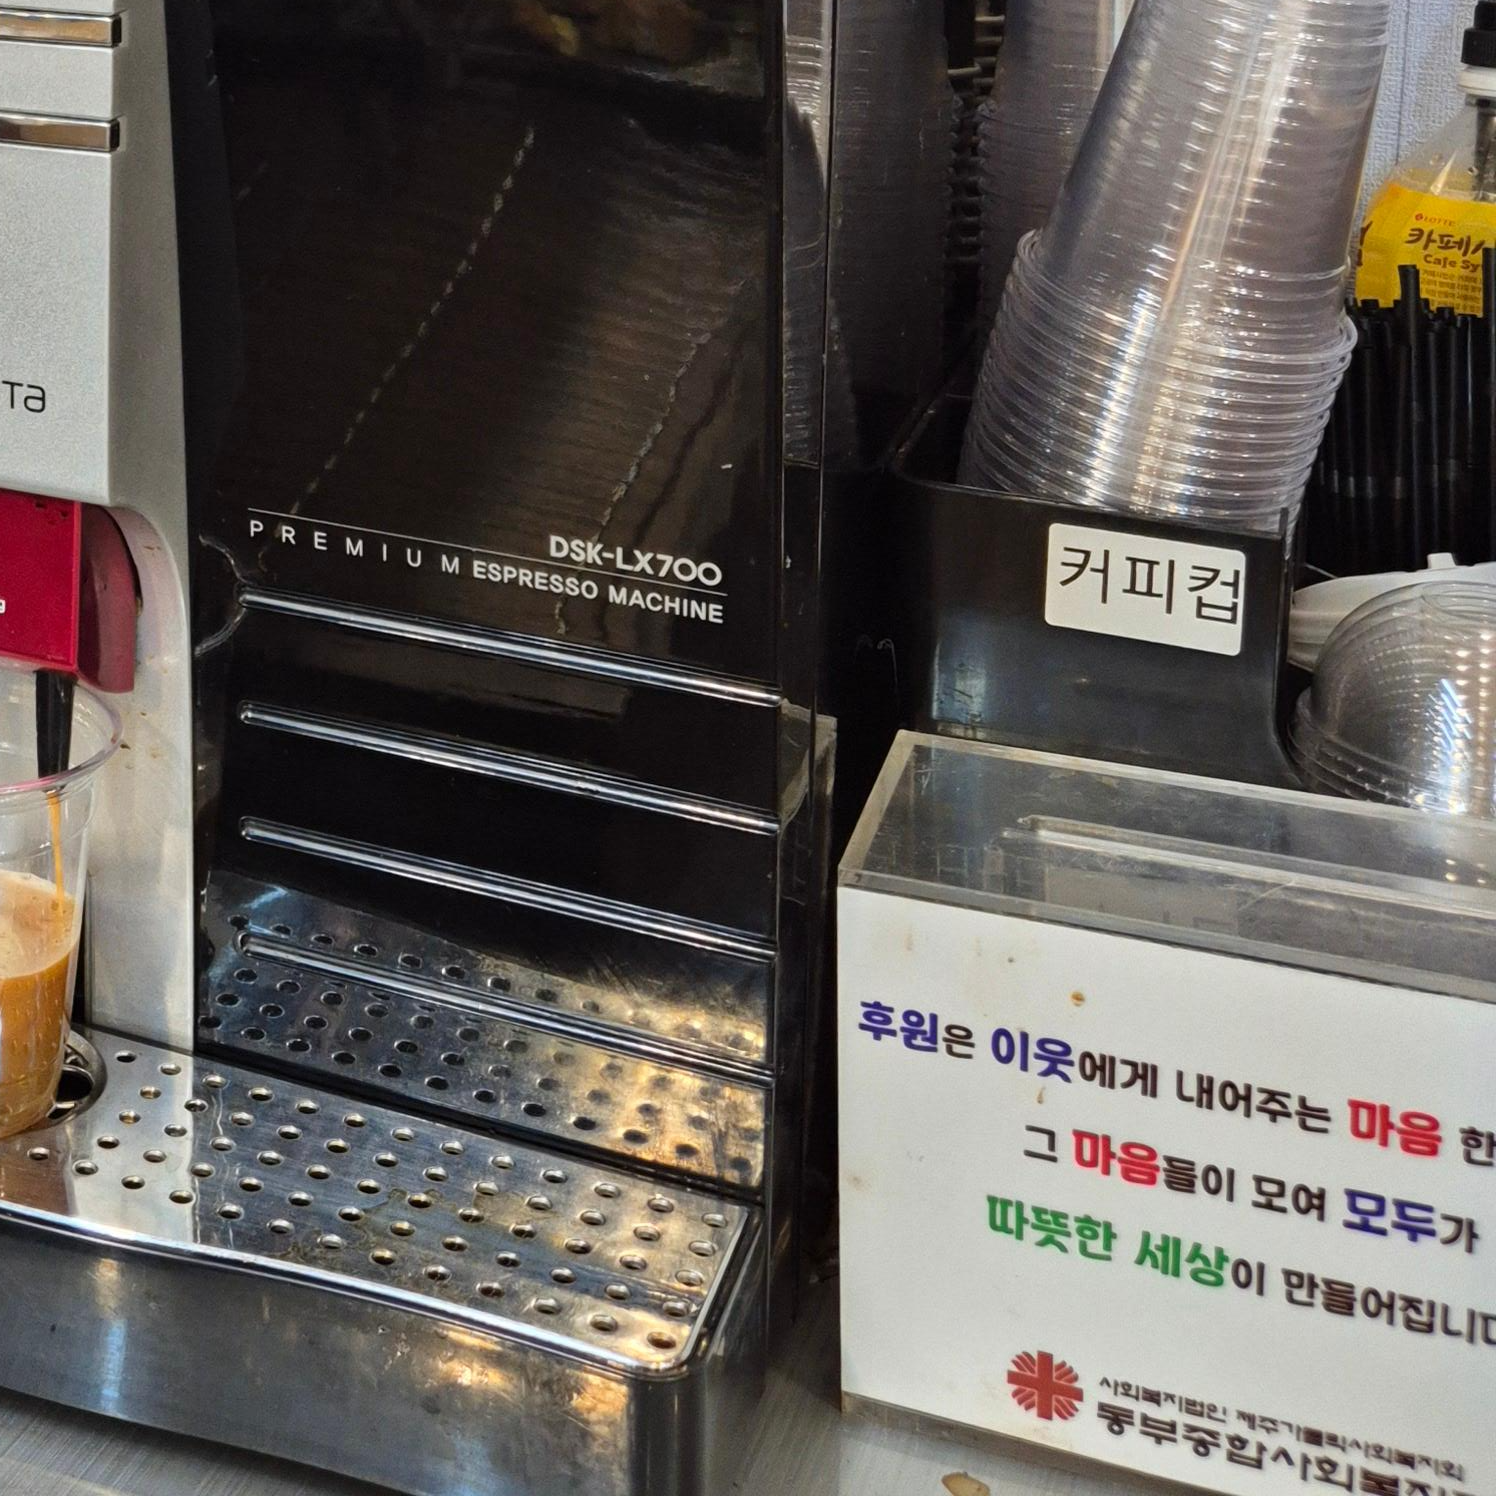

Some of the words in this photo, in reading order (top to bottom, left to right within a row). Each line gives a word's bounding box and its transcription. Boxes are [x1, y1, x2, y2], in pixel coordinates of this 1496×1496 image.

[1423, 253, 1457, 269] Cafe
[1459, 259, 1482, 273] Sy
[472, 560, 600, 601] ESPRESSO
[608, 584, 726, 624] MACHINE
[548, 534, 724, 588] DSK-LX700
[1058, 546, 1241, 625] 커피컵
[858, 1000, 977, 1060] 후원은
[990, 1026, 1159, 1098] 이웃에게
[1175, 1069, 1333, 1135] 내어주는
[1346, 1097, 1444, 1159] 마음
[1022, 1123, 1059, 1163] 그
[1071, 1127, 1236, 1203] 마음들이
[1251, 1172, 1327, 1223] 모여
[1342, 1187, 1480, 1255] 모두가
[986, 1193, 1117, 1263] 따뜻한
[1133, 1229, 1266, 1298] 세상이
